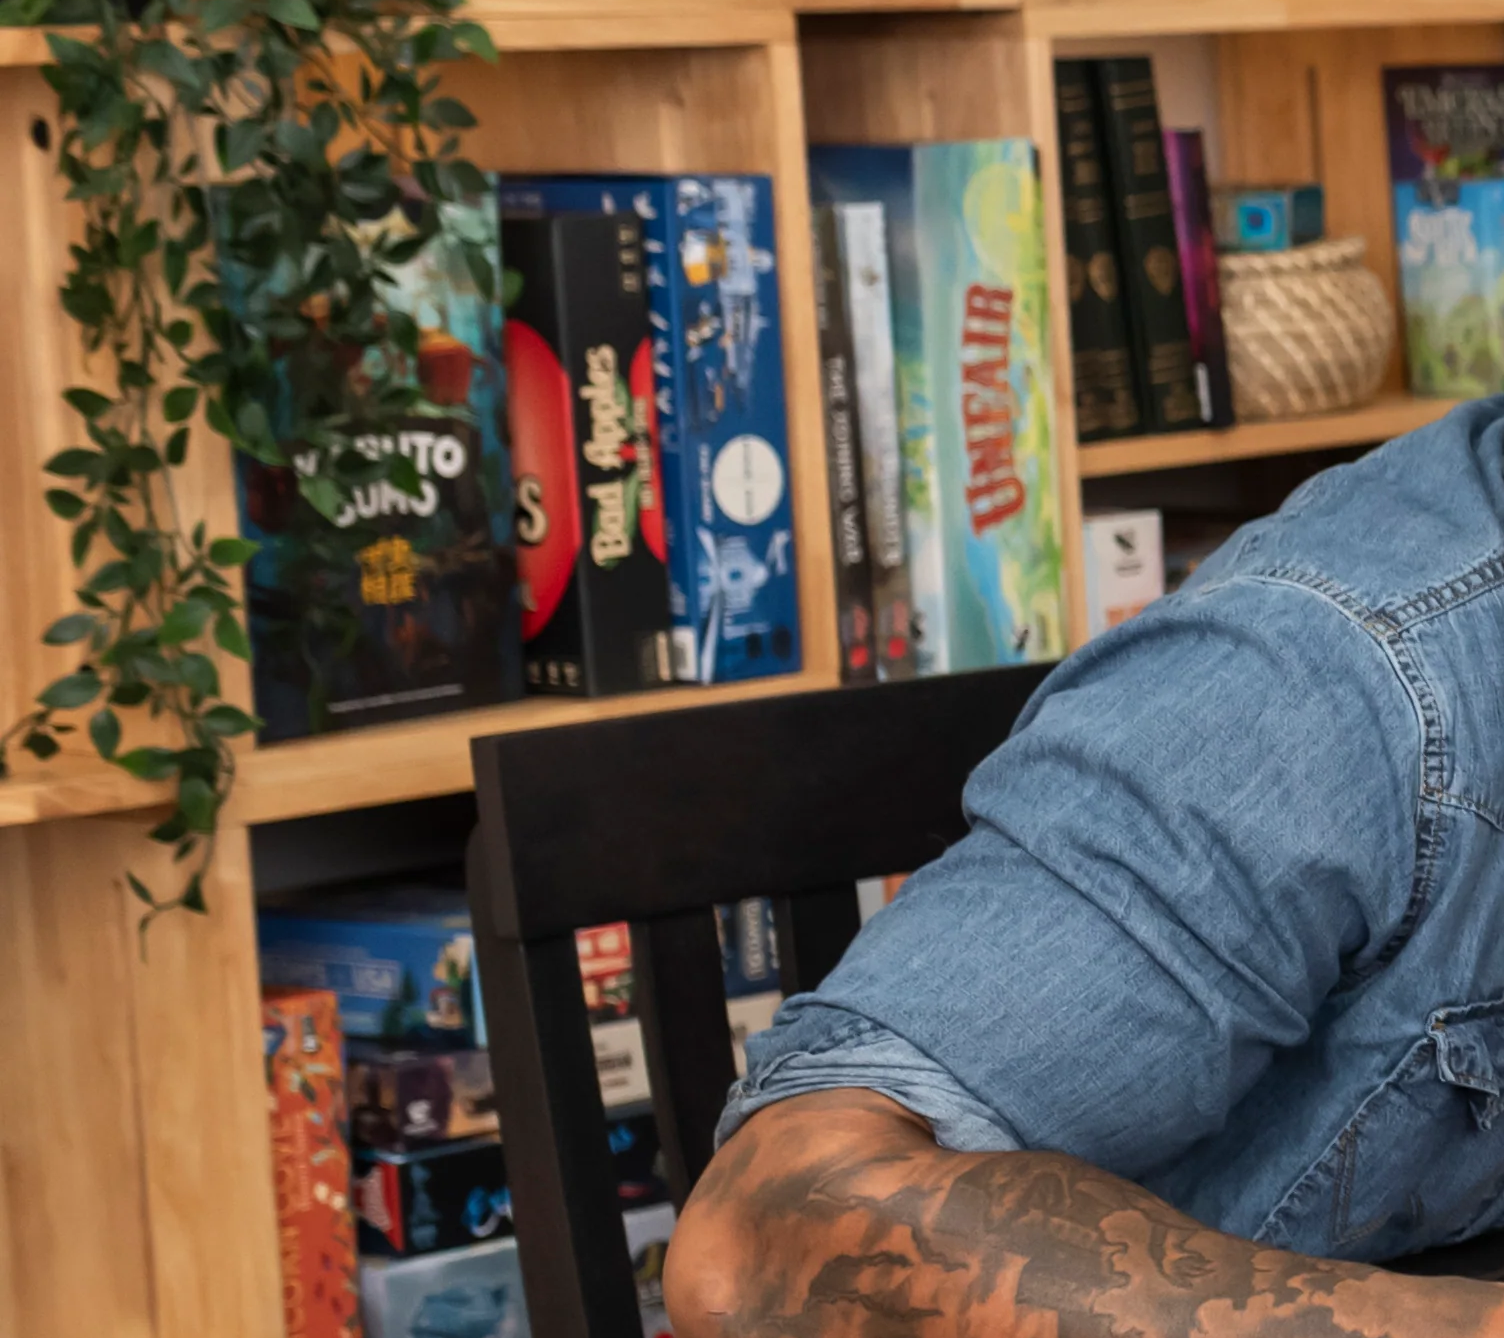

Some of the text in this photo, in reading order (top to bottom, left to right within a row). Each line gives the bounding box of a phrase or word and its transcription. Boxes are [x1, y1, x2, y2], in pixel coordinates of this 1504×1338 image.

[578, 342, 632, 567] Bad Apples
[961, 282, 1027, 538] UNFAIR
